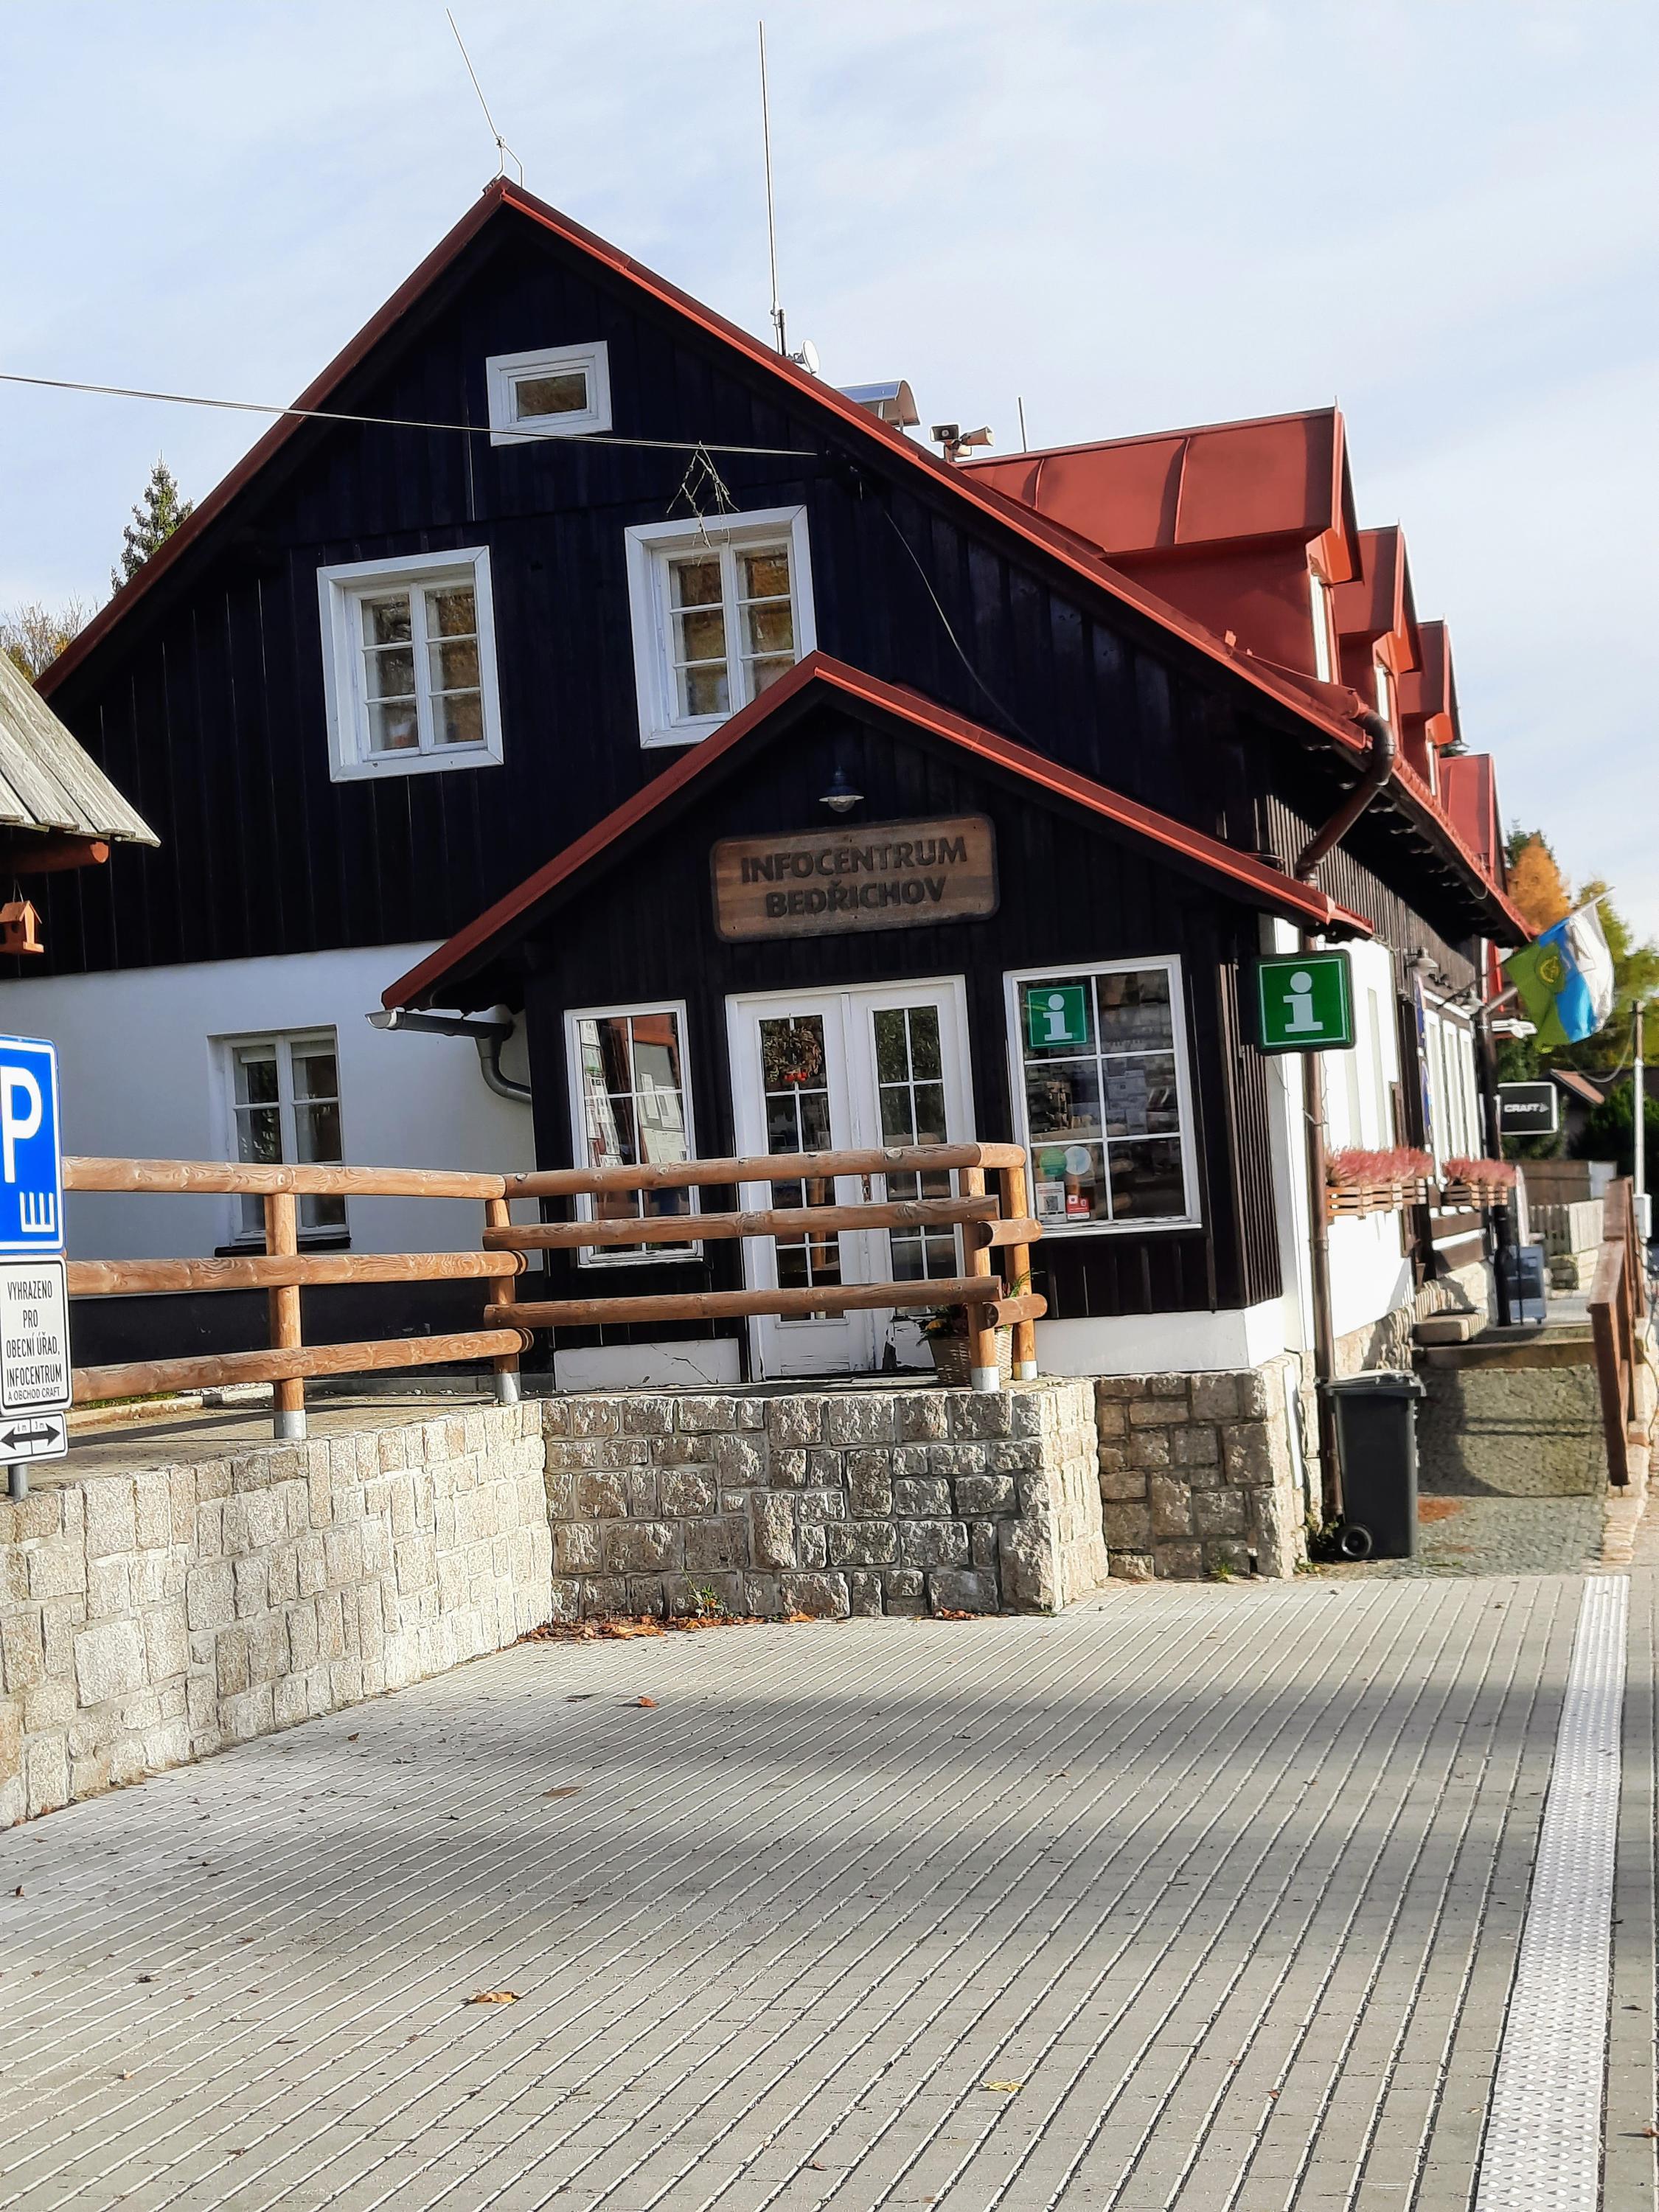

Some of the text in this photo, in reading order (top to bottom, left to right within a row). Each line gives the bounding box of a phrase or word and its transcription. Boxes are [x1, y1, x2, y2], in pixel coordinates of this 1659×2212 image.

[741, 836, 968, 884] INFOCENTRUM
[765, 876, 947, 919] BEDŘICHOV
[0, 1066, 42, 1183] P
[7, 1279, 53, 1301] VYHRAZENO
[23, 1308, 38, 1329] PRO
[6, 1332, 35, 1358] OBECNÍ
[6, 1363, 62, 1388] INFOCENTRUM
[8, 1386, 60, 1402] A OBCHOD CRAFT
